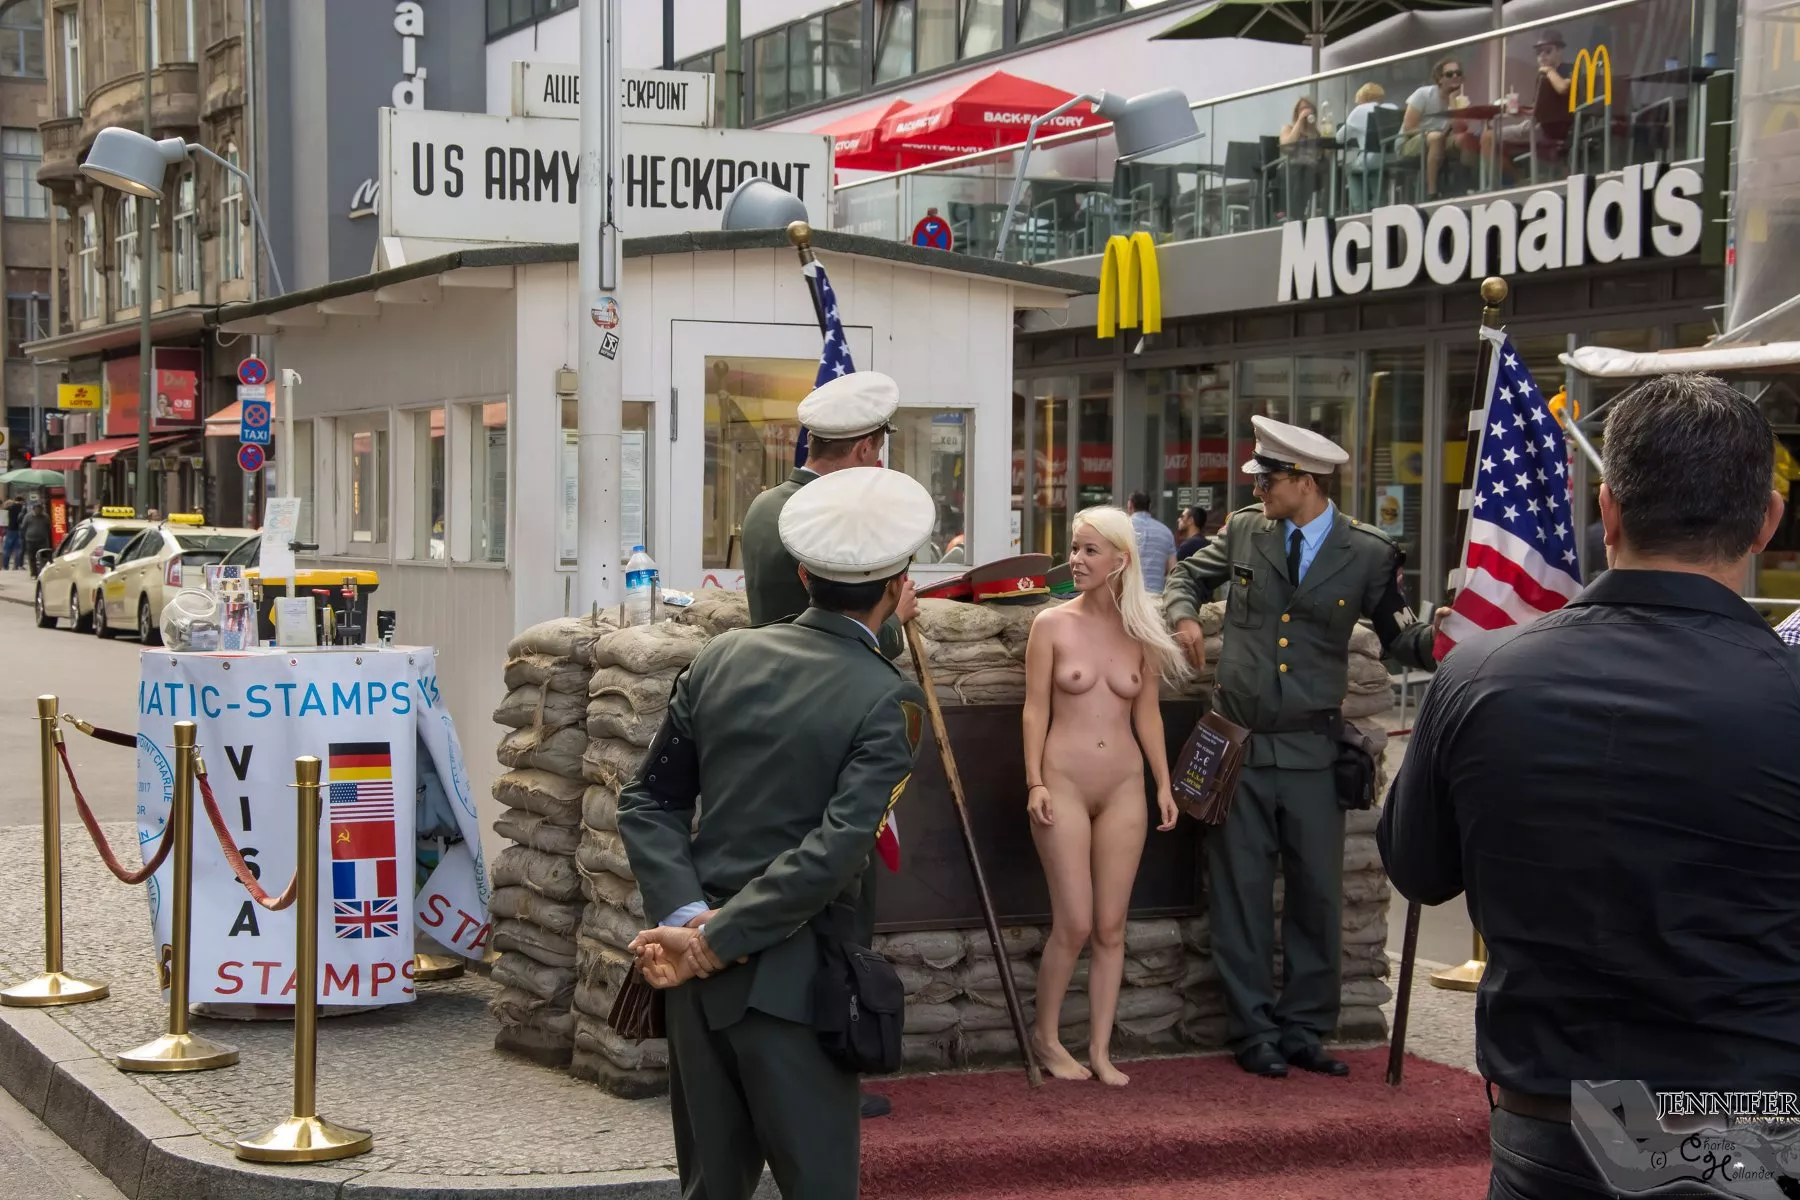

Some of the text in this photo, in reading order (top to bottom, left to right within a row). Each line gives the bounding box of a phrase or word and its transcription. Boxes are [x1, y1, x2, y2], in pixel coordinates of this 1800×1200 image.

[543, 74, 579, 104] ALLIE
[412, 142, 464, 198] US
[485, 147, 579, 204] ARMY
[1278, 161, 1702, 301] McDonald's
[243, 429, 268, 441] TAXI
[153, 755, 172, 802] CHARLIE
